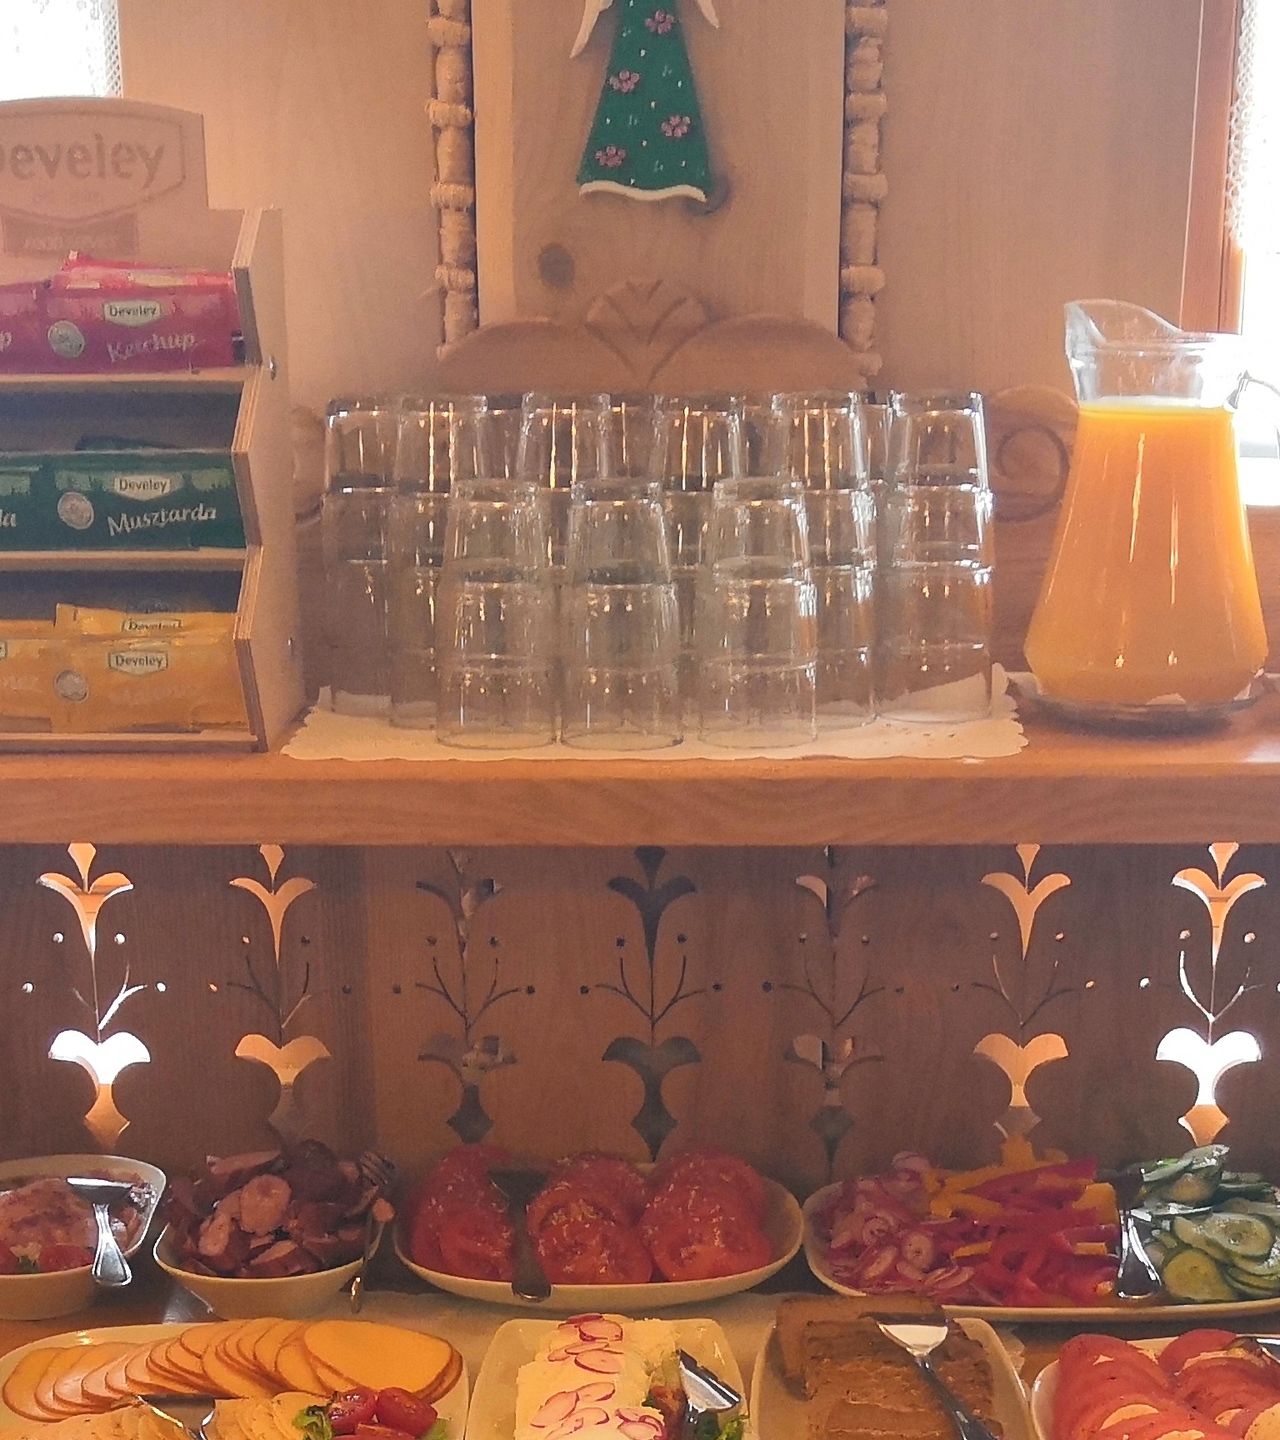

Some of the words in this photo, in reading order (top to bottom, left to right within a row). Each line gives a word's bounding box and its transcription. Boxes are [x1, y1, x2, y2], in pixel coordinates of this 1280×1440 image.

[109, 303, 157, 318] Develey
[107, 332, 196, 363] Ketchup
[120, 478, 168, 493] Develey
[107, 503, 218, 537] Musztarda
[115, 655, 164, 668] Develey
